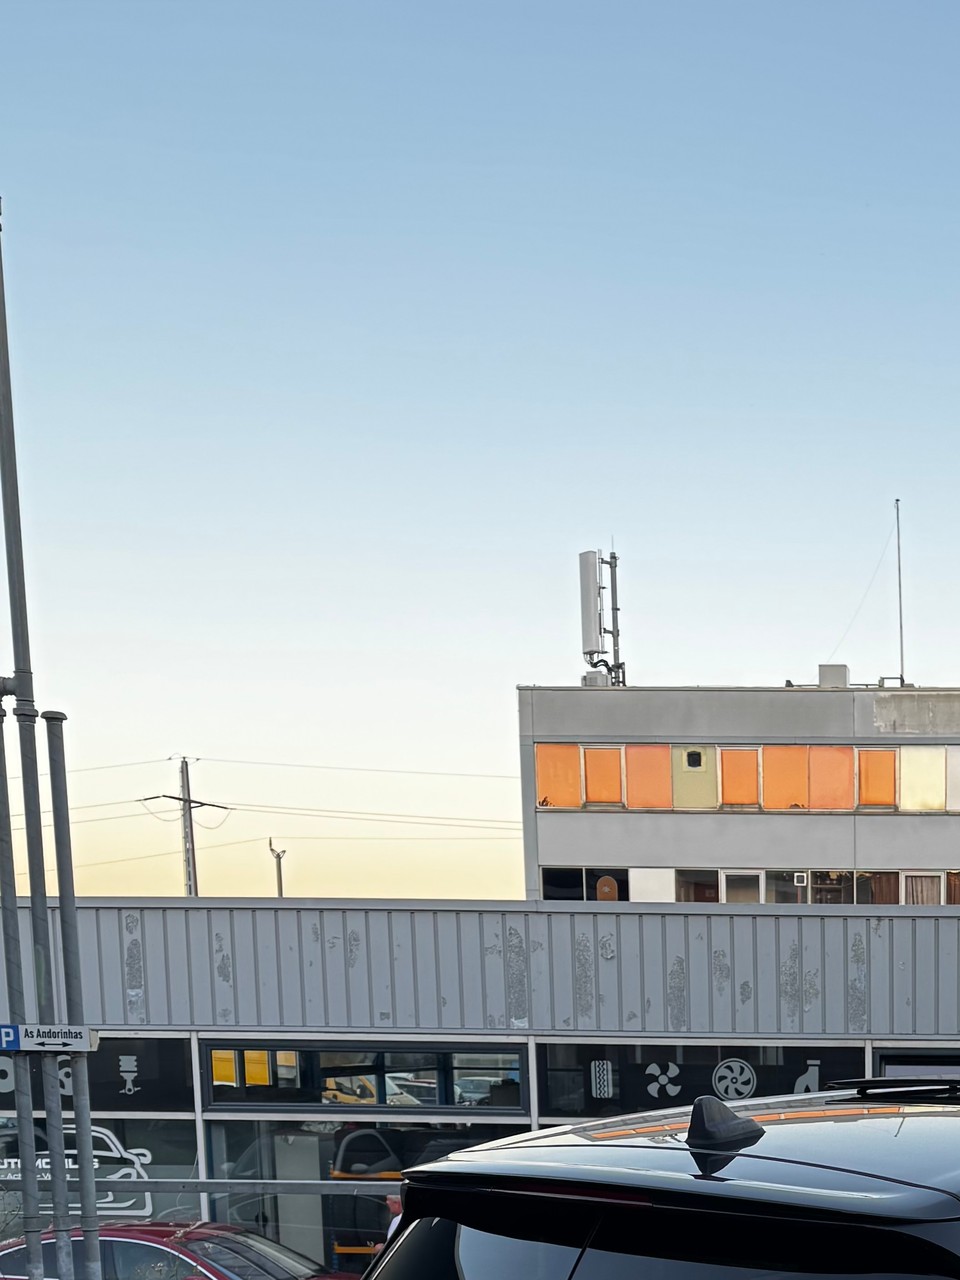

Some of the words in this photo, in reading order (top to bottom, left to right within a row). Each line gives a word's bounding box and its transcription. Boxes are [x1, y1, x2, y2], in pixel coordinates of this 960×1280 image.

[1, 1028, 14, 1048] P
[24, 1028, 34, 1039] As
[36, 1028, 83, 1040] Andorinhas
